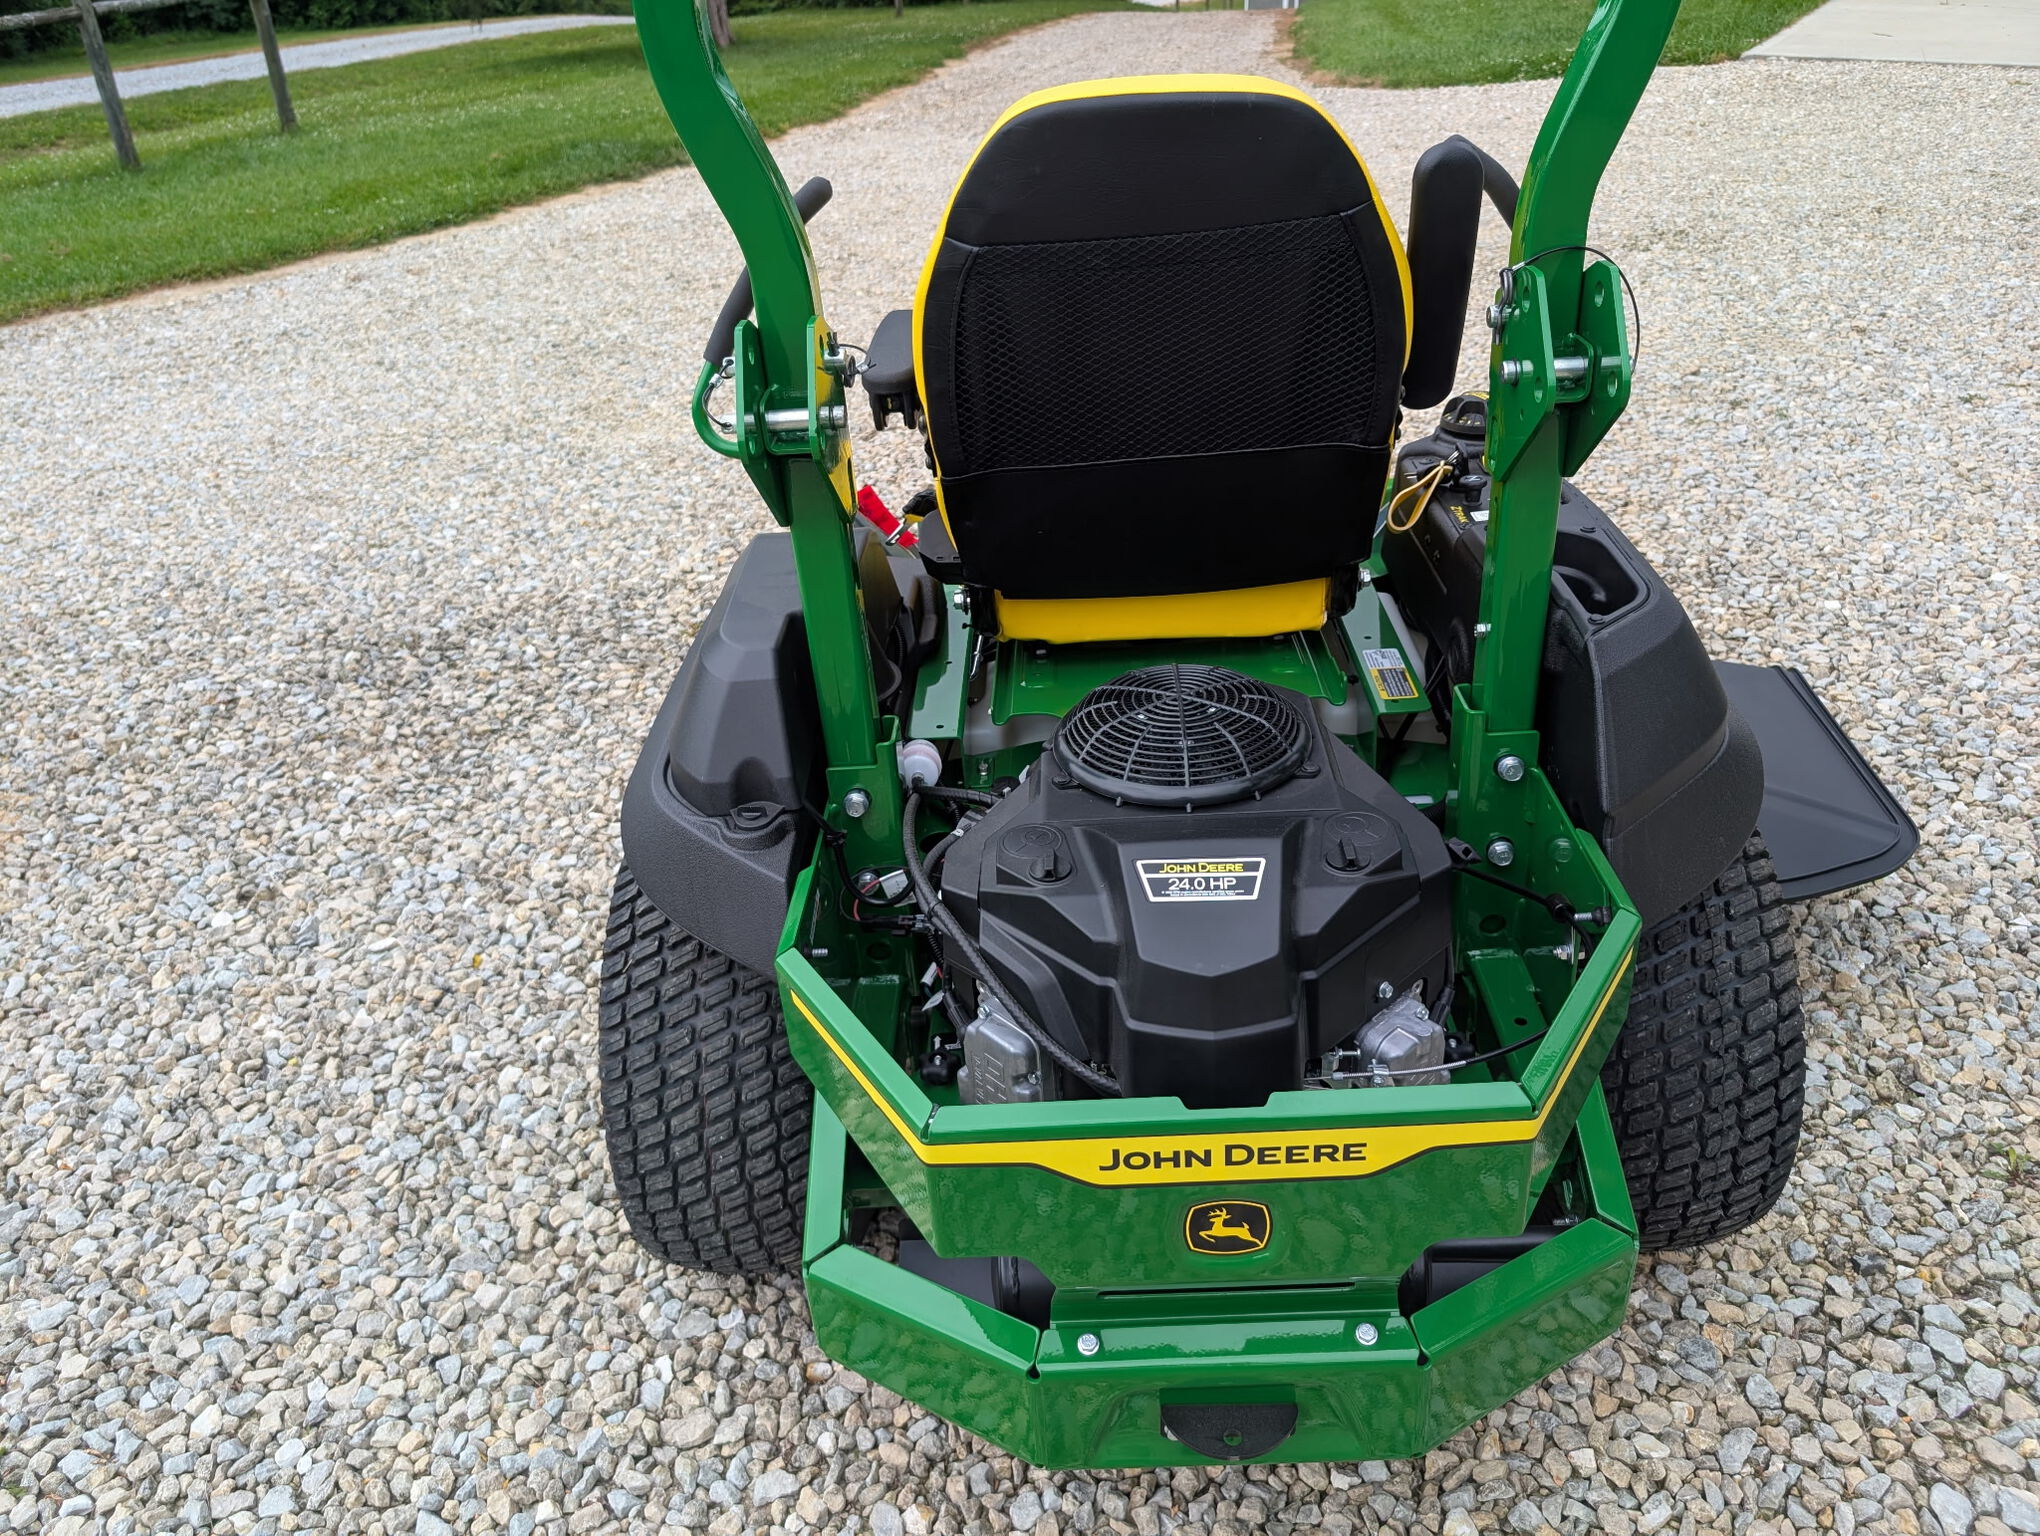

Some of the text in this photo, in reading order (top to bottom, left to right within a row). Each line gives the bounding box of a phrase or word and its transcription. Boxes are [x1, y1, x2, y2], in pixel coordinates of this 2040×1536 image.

[1159, 862, 1244, 873] JOHN DEERE
[1168, 877, 1237, 890] 24.0 HP
[1099, 1143, 1368, 1171] JOHN DEERE
